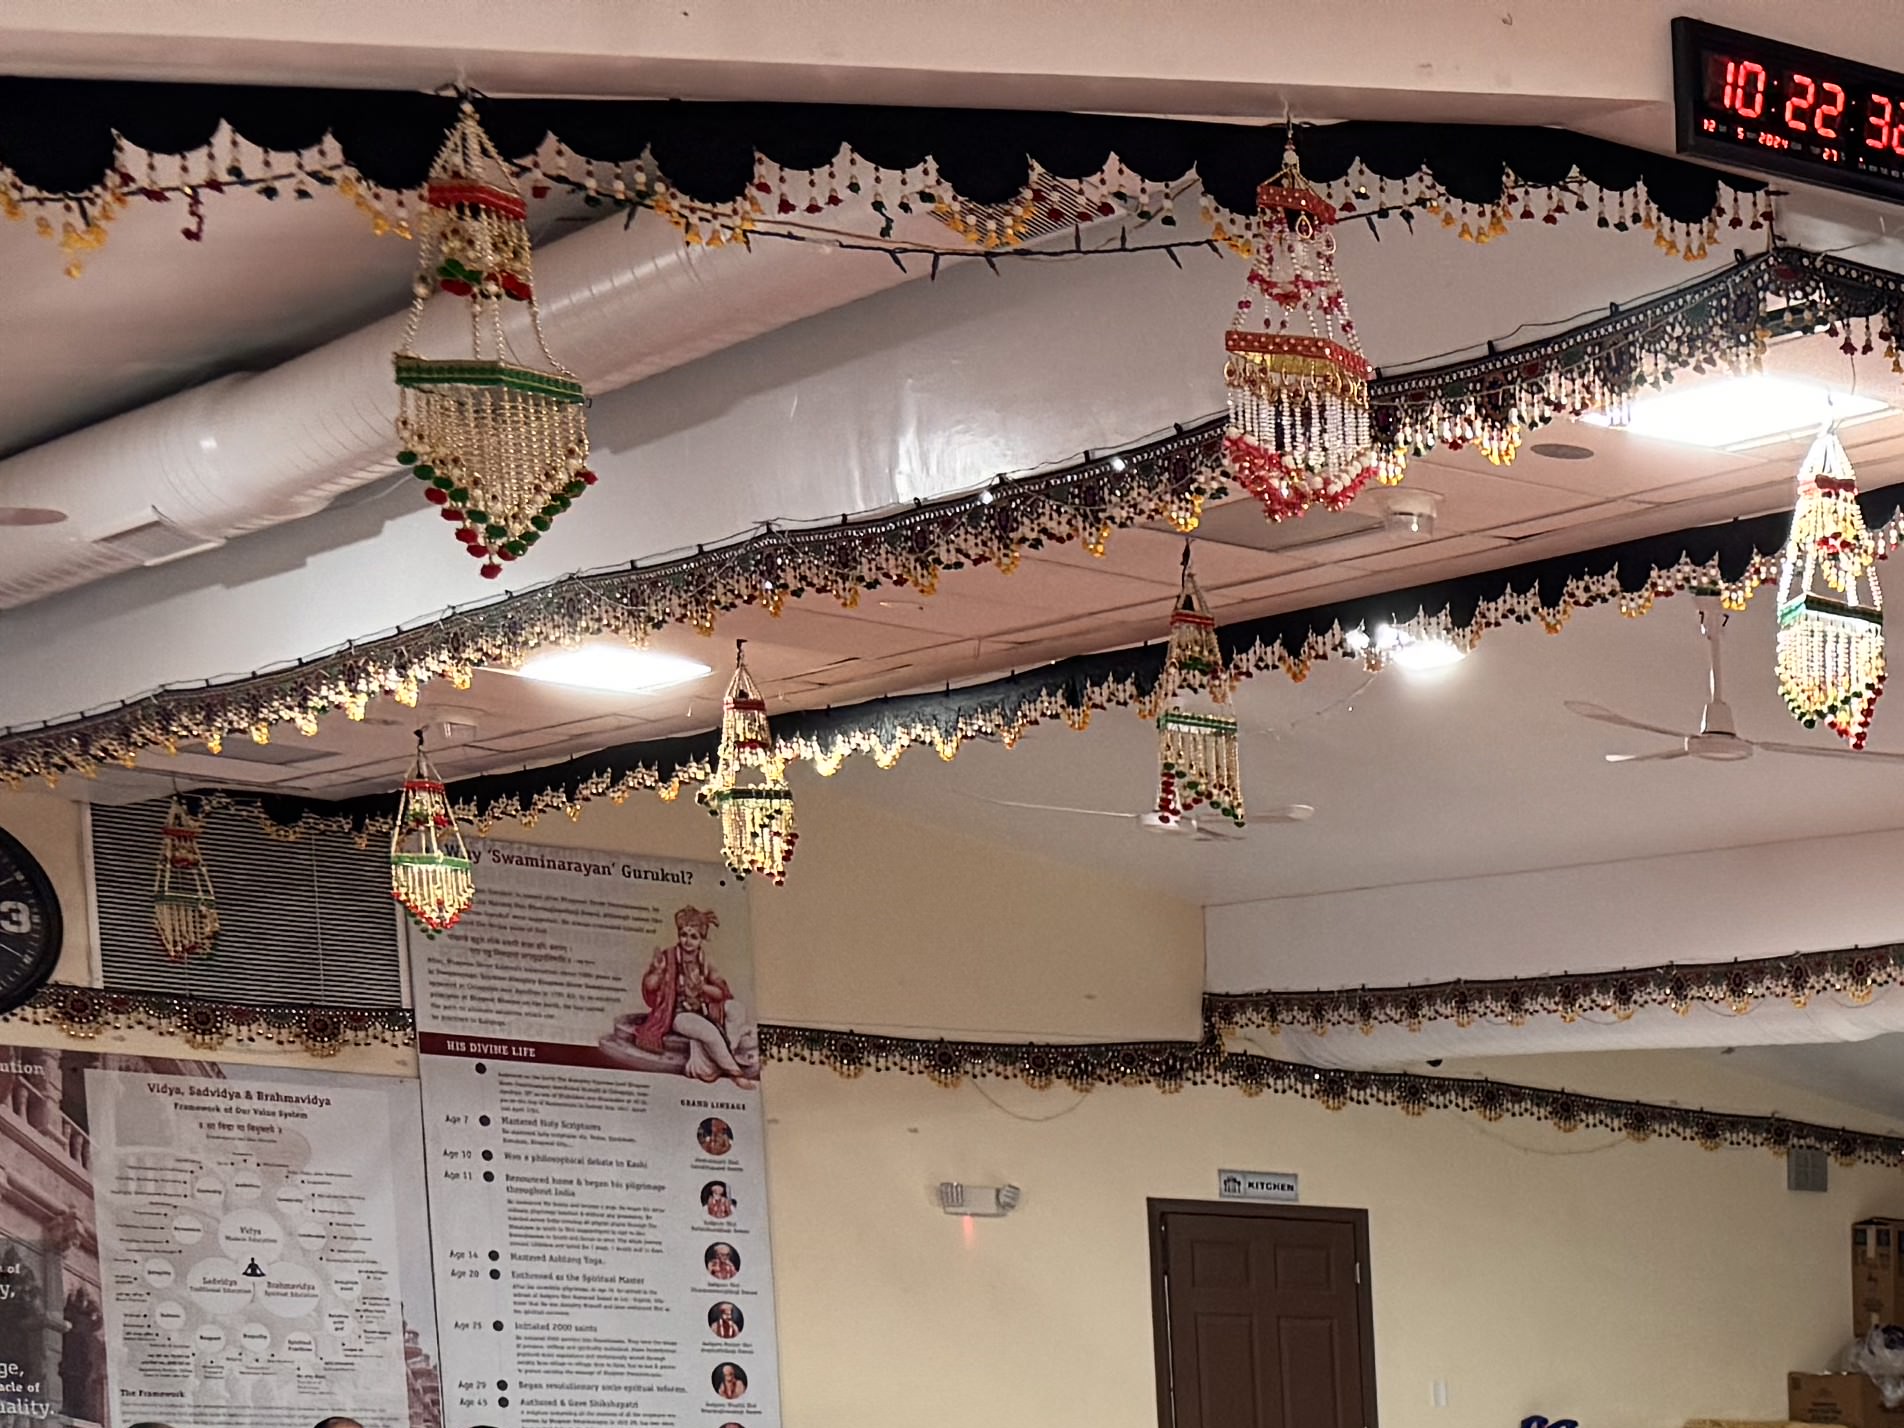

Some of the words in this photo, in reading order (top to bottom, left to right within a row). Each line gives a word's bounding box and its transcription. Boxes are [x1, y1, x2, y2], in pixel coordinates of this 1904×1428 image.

[1758, 132, 1788, 149] 2024
[622, 864, 693, 885] Gurukul?
[447, 1040, 466, 1052] HIS
[470, 1042, 509, 1055] DIVINE
[512, 1046, 536, 1057] LIFE
[147, 1083, 184, 1097] Vidya,
[189, 1086, 241, 1100] Sadvidya
[257, 1090, 331, 1108] Brahmavidya
[680, 1099, 708, 1108] GRAND
[174, 1102, 221, 1113] Framework
[253, 1107, 276, 1117] Value
[278, 1110, 308, 1120] System
[445, 1114, 461, 1124] Age
[443, 1149, 459, 1159] Age
[444, 1170, 460, 1180] Age
[1248, 1181, 1295, 1192] KITCHEN
[450, 1250, 465, 1260] Age
[7, 1263, 20, 1274] of
[454, 1321, 469, 1331] Age
[552, 1324, 572, 1332] 2000
[27, 1382, 40, 1392] of
[120, 1389, 136, 1397] The
[138, 1389, 185, 1398] Framework
